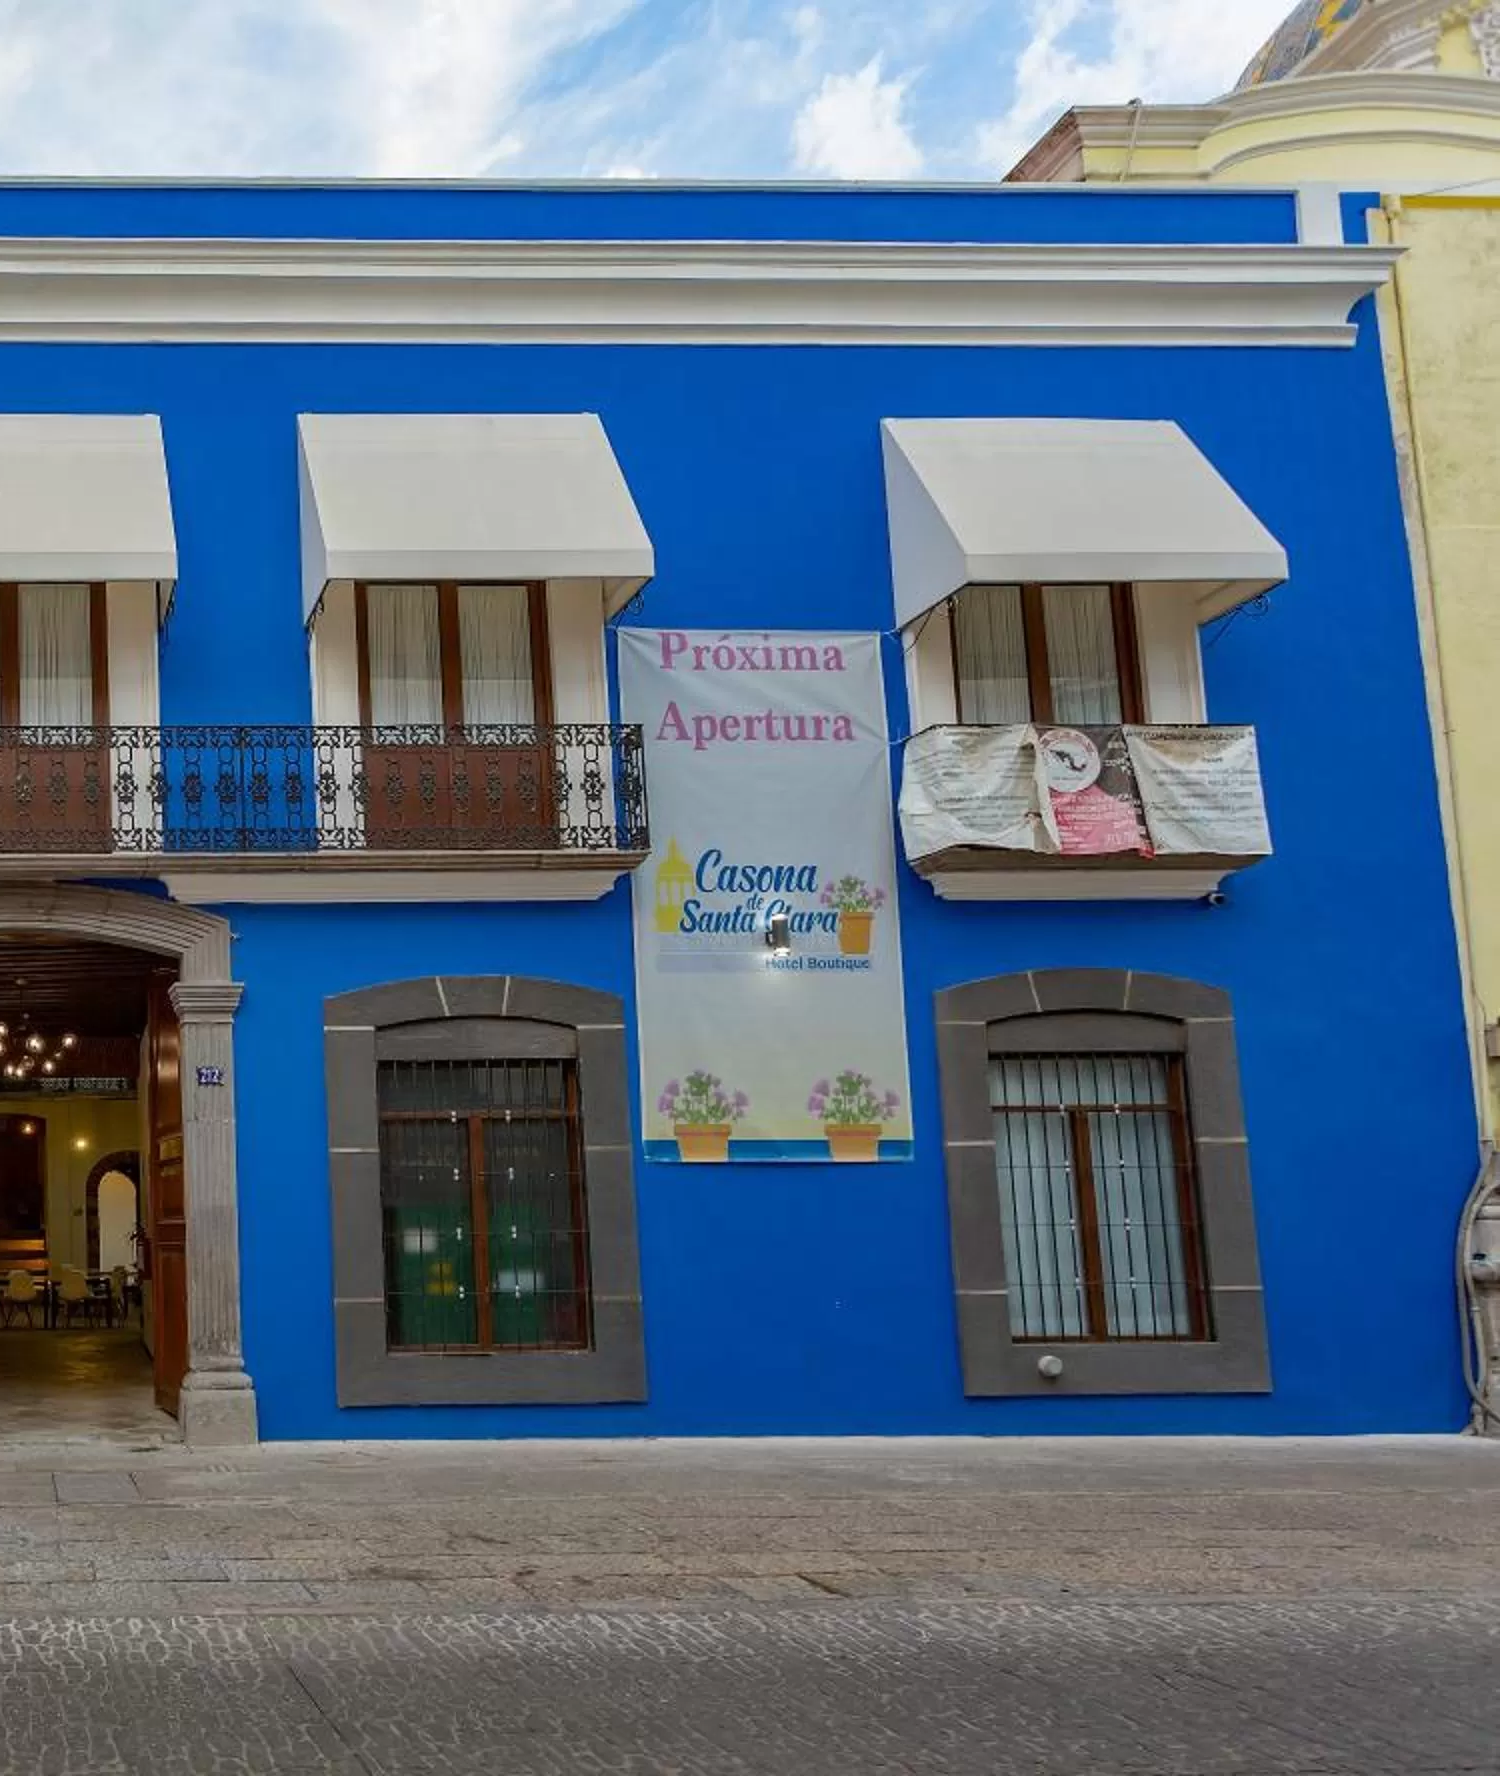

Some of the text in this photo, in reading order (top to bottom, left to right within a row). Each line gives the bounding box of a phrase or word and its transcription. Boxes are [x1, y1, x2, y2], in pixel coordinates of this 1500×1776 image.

[656, 631, 846, 672] Próxima
[655, 701, 856, 751] Apertura
[695, 849, 819, 893] Casona
[679, 899, 757, 934] Santa
[746, 893, 765, 911] de
[765, 957, 870, 972] Hotel Boutique
